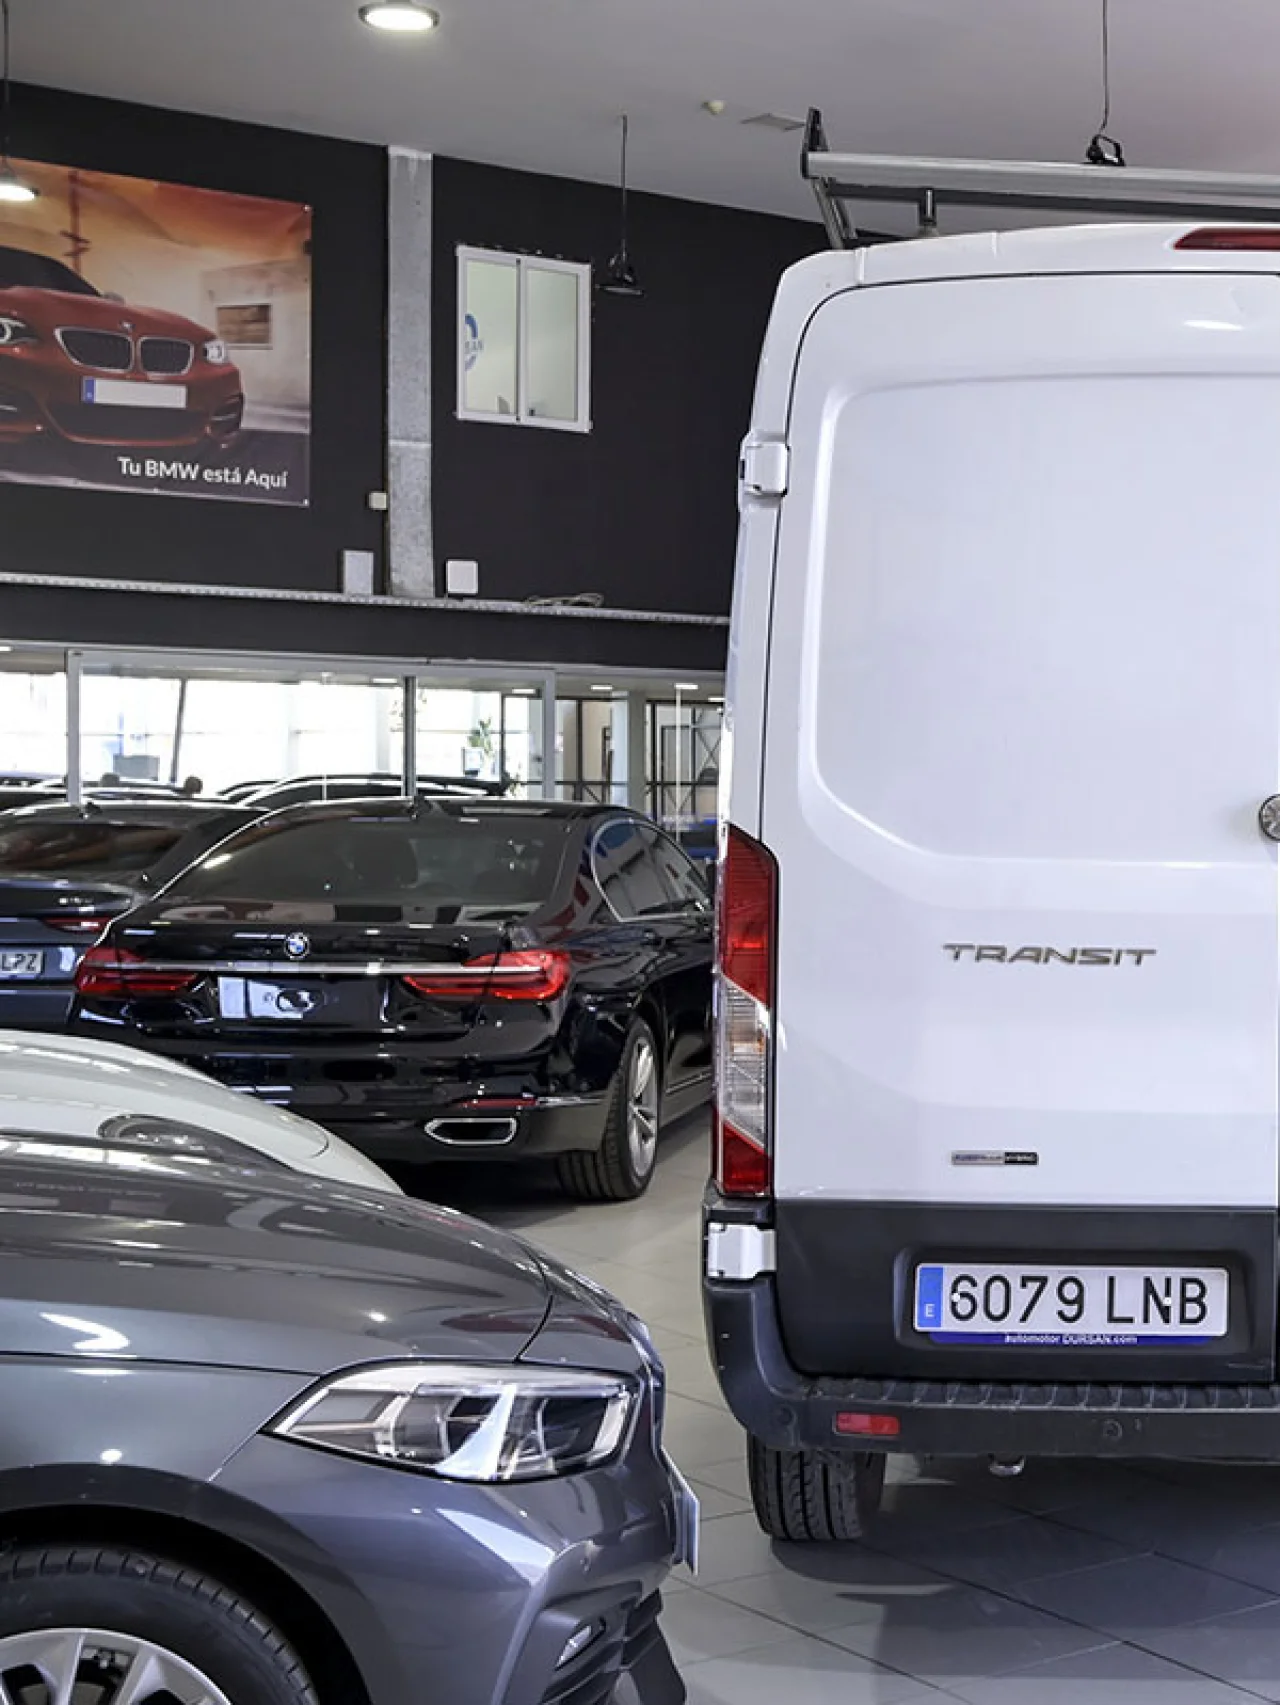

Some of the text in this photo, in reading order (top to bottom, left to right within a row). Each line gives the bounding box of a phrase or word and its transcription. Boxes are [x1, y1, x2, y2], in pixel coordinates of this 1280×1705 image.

[117, 456, 288, 489] Tu BMW está Aquí
[943, 943, 1157, 966] TRANSIT
[924, 1273, 1208, 1325] E 6079 LNB
